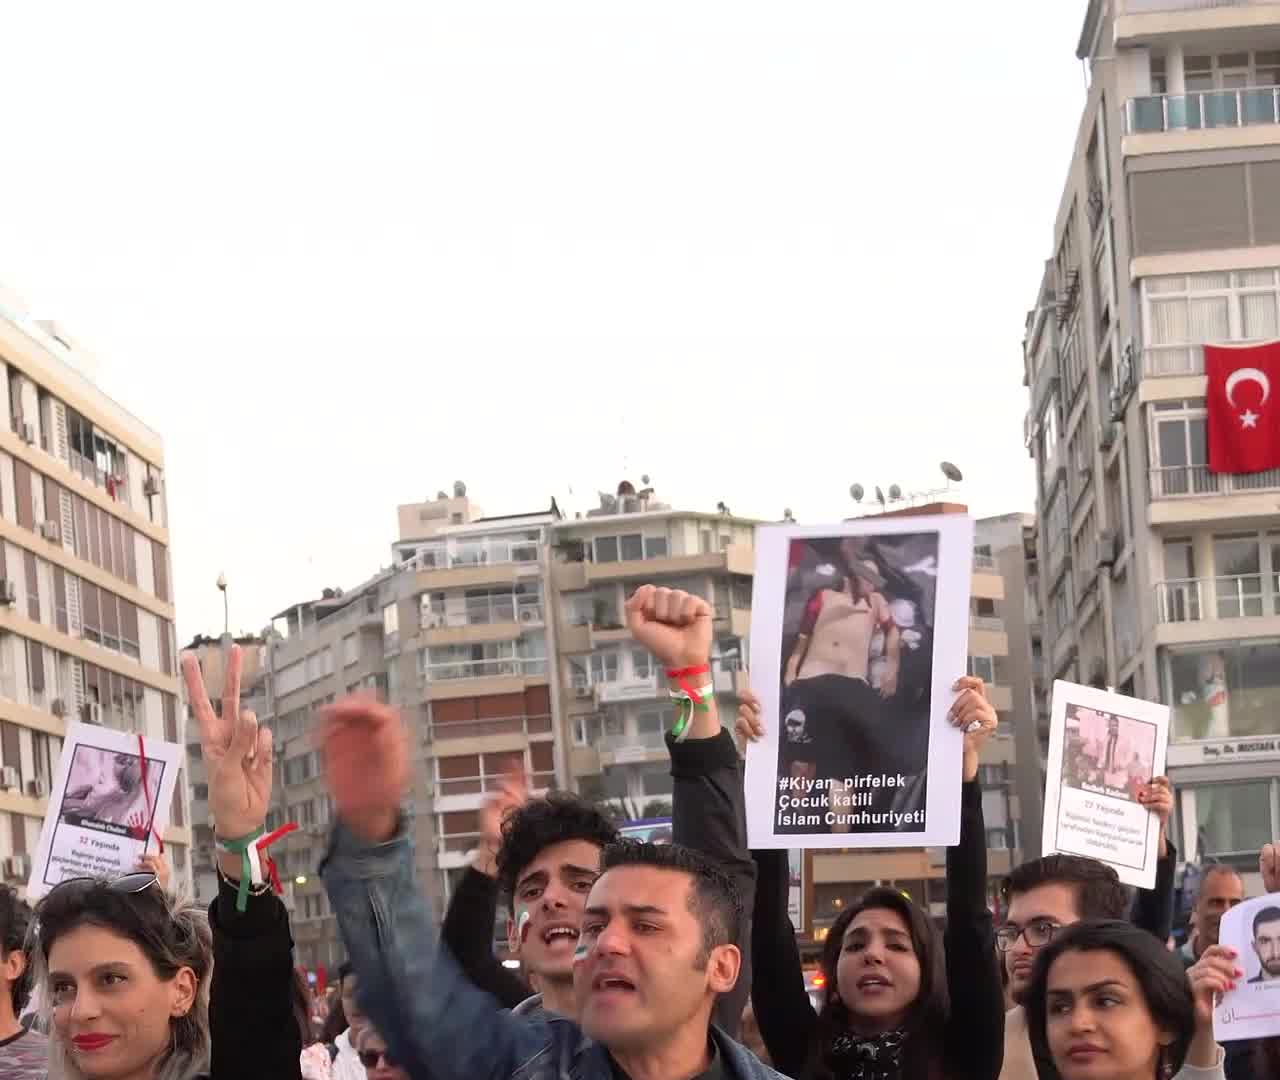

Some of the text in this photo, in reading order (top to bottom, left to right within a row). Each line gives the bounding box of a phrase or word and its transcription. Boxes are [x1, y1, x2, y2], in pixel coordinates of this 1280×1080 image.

[778, 773, 906, 793] #Kiyan_pirfelek
[778, 792, 873, 811] Çocuk katili
[777, 809, 925, 827] İslam Cumhuriyeti
